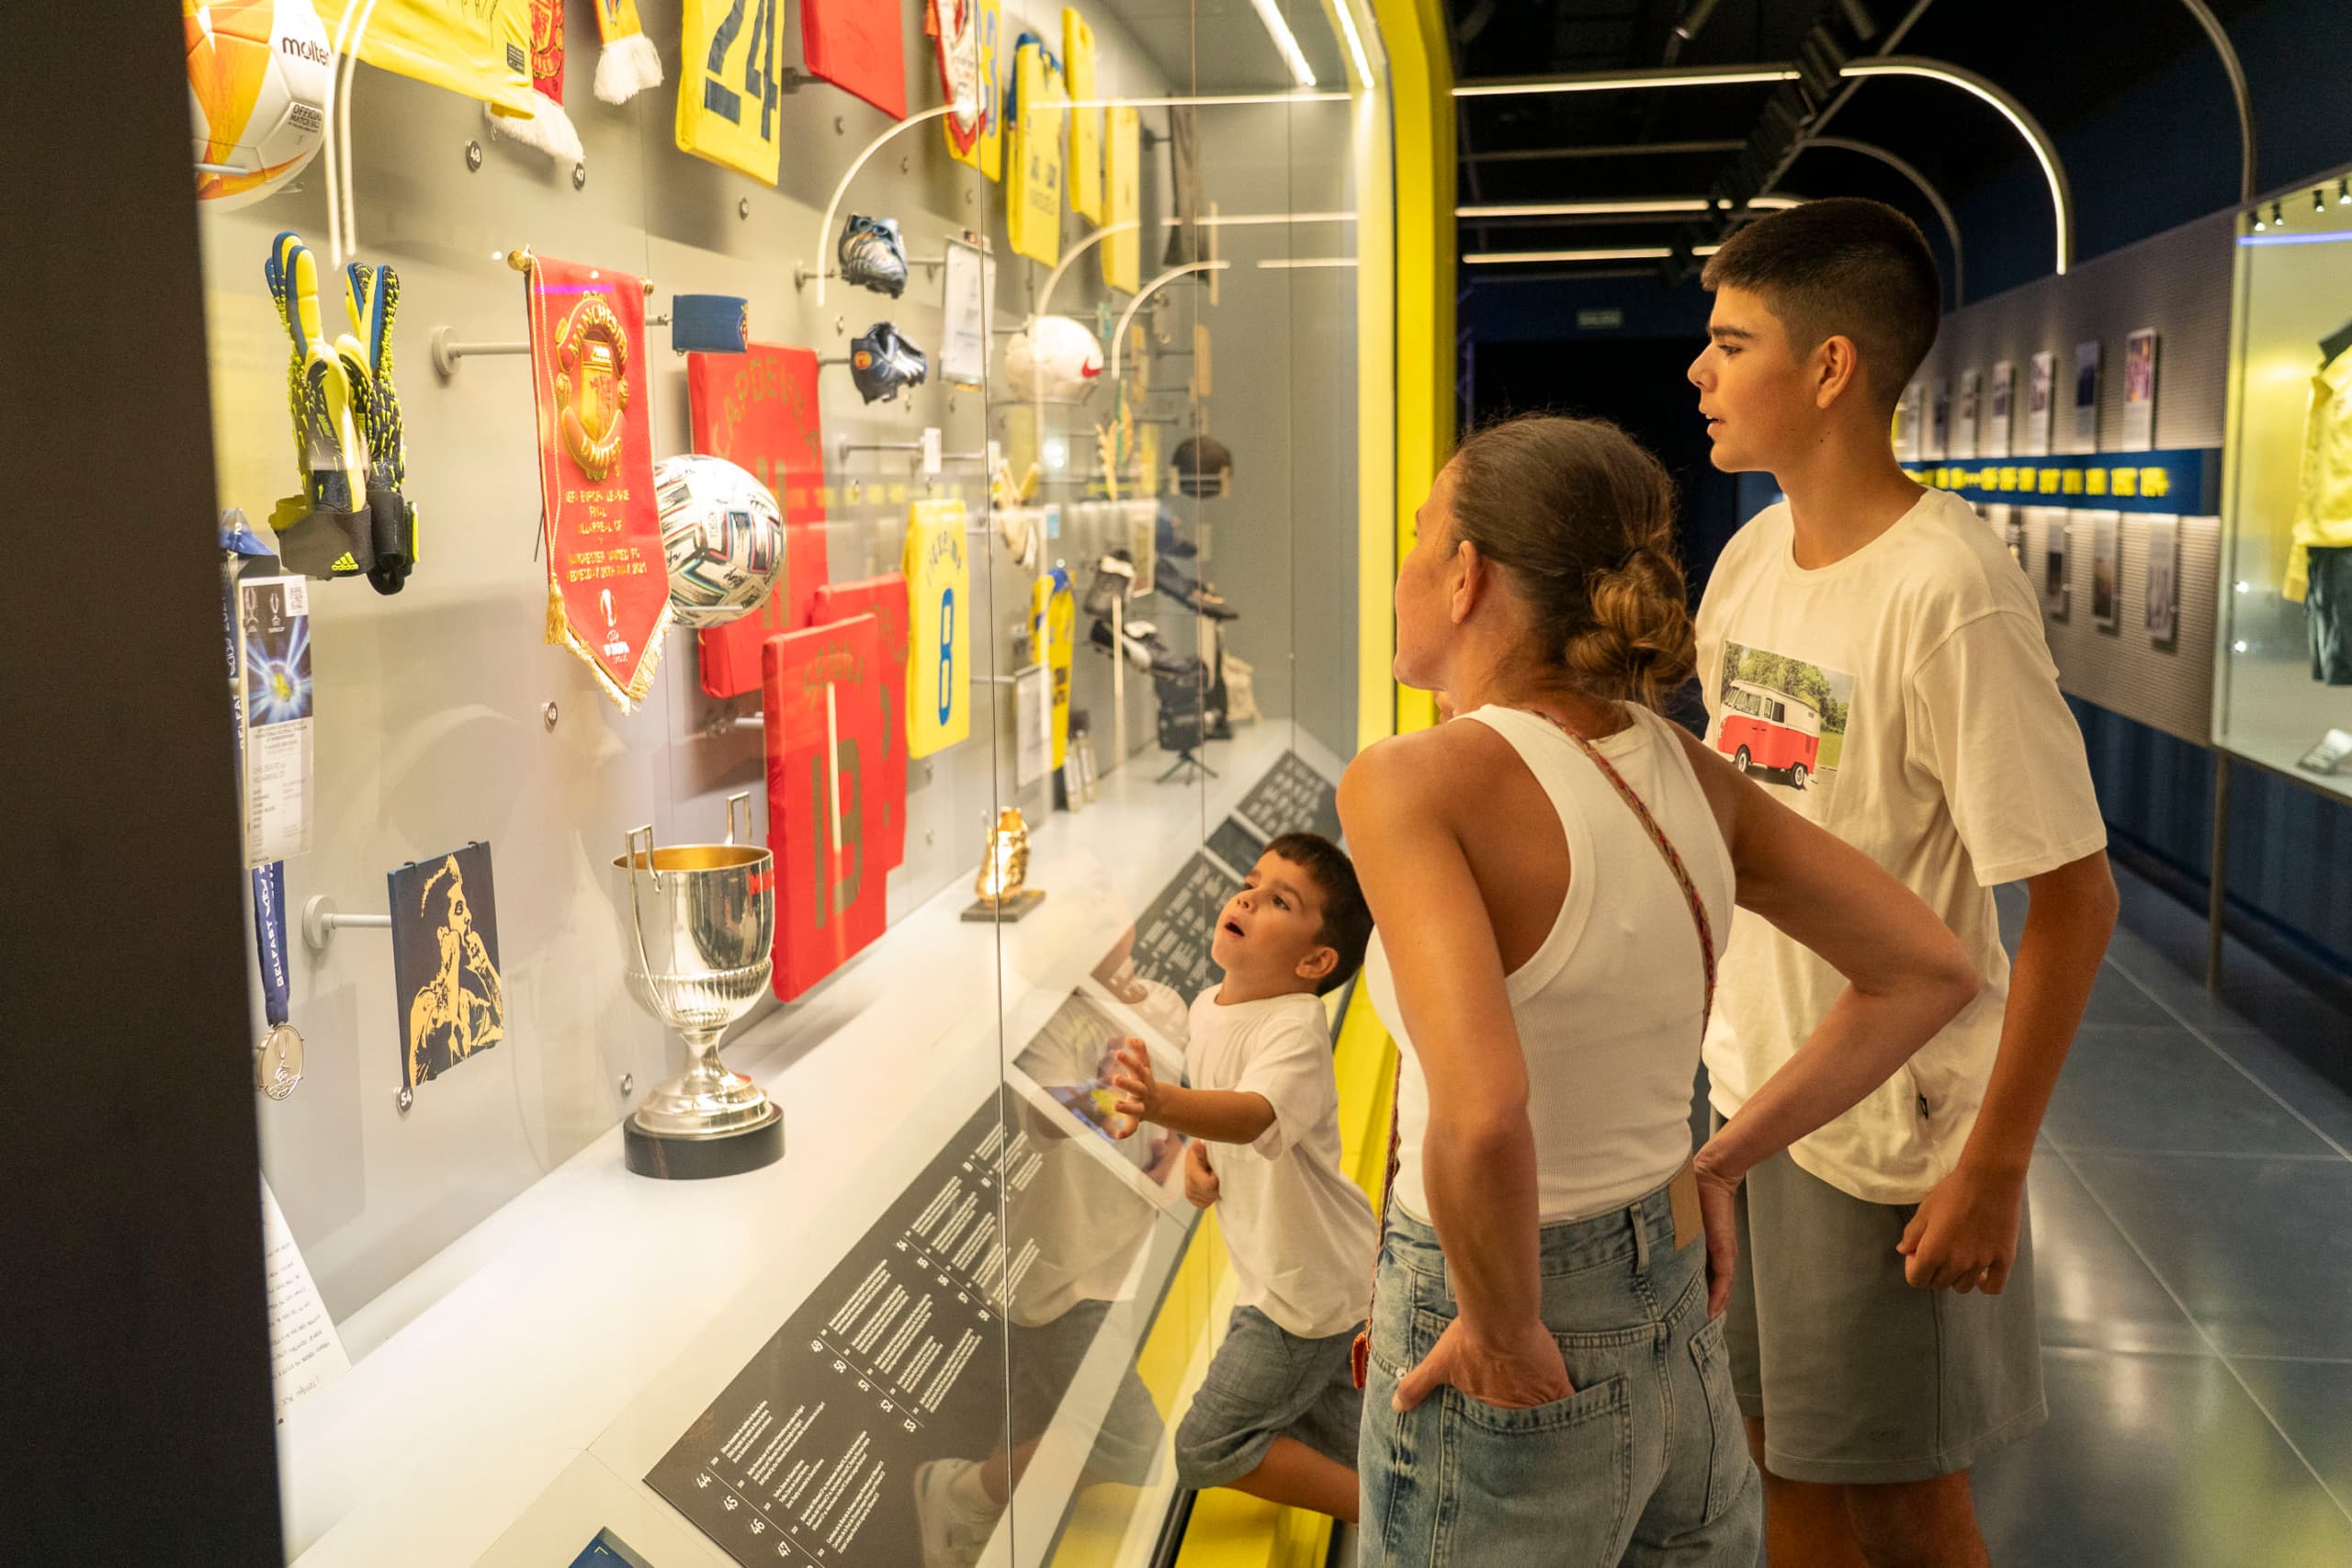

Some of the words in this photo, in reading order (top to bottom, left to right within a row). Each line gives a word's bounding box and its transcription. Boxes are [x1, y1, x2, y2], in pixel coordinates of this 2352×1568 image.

[711, 355, 820, 466] CAPDEVILA
[938, 587, 955, 727] 8
[811, 738, 864, 929] 19
[266, 920, 285, 987] BELFAST
[401, 1090, 412, 1107] 54
[834, 1360, 846, 1372] 50
[858, 1380, 870, 1391] 51
[881, 1400, 893, 1412] 52
[697, 1473, 711, 1488] 44
[724, 1495, 738, 1510] 45
[751, 1518, 764, 1534] 46
[778, 1541, 790, 1556] 47
